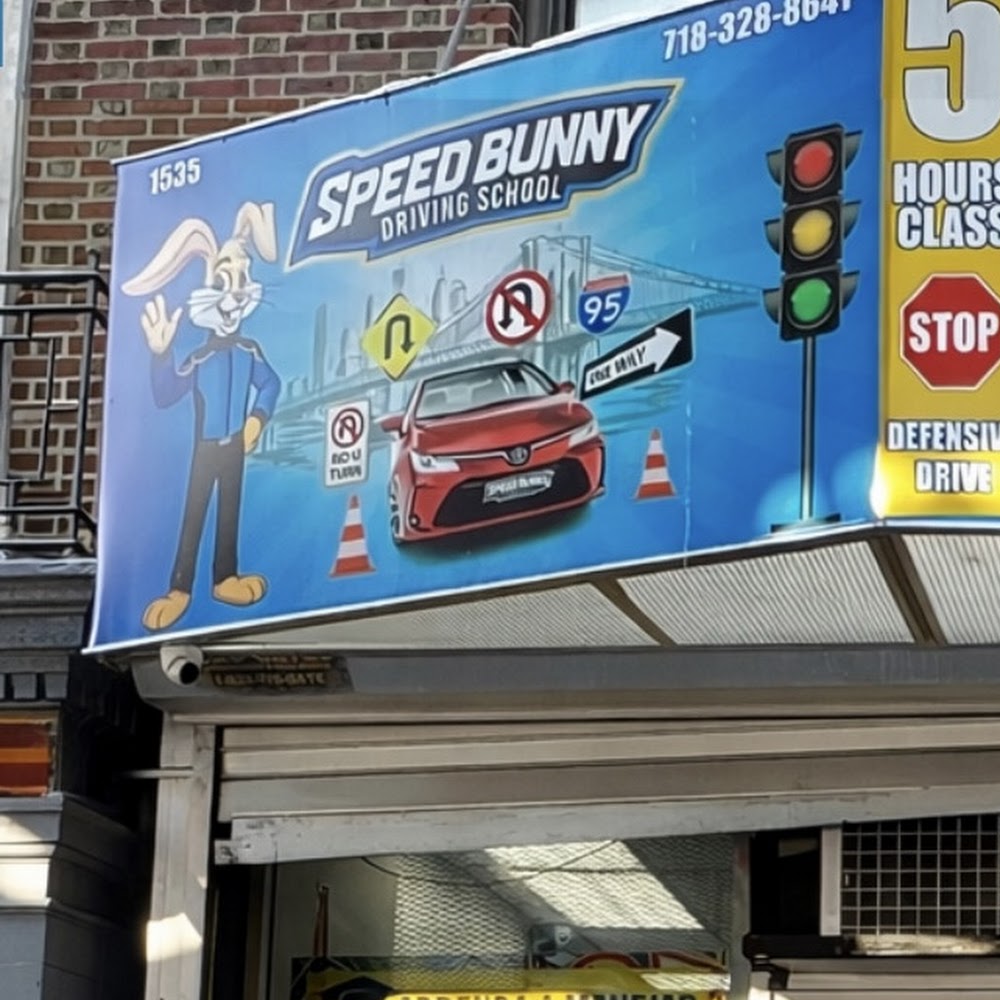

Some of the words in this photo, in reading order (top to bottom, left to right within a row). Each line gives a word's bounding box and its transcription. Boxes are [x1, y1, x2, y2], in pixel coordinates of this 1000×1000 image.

[149, 157, 201, 195] 1535
[308, 139, 473, 242] SPEED
[473, 103, 652, 185] BUNNY
[381, 192, 470, 242] DRIVING
[477, 174, 562, 212] SCHOOL
[584, 291, 623, 325] 95
[908, 310, 1000, 353] STOP
[915, 459, 993, 493] DRIVE
